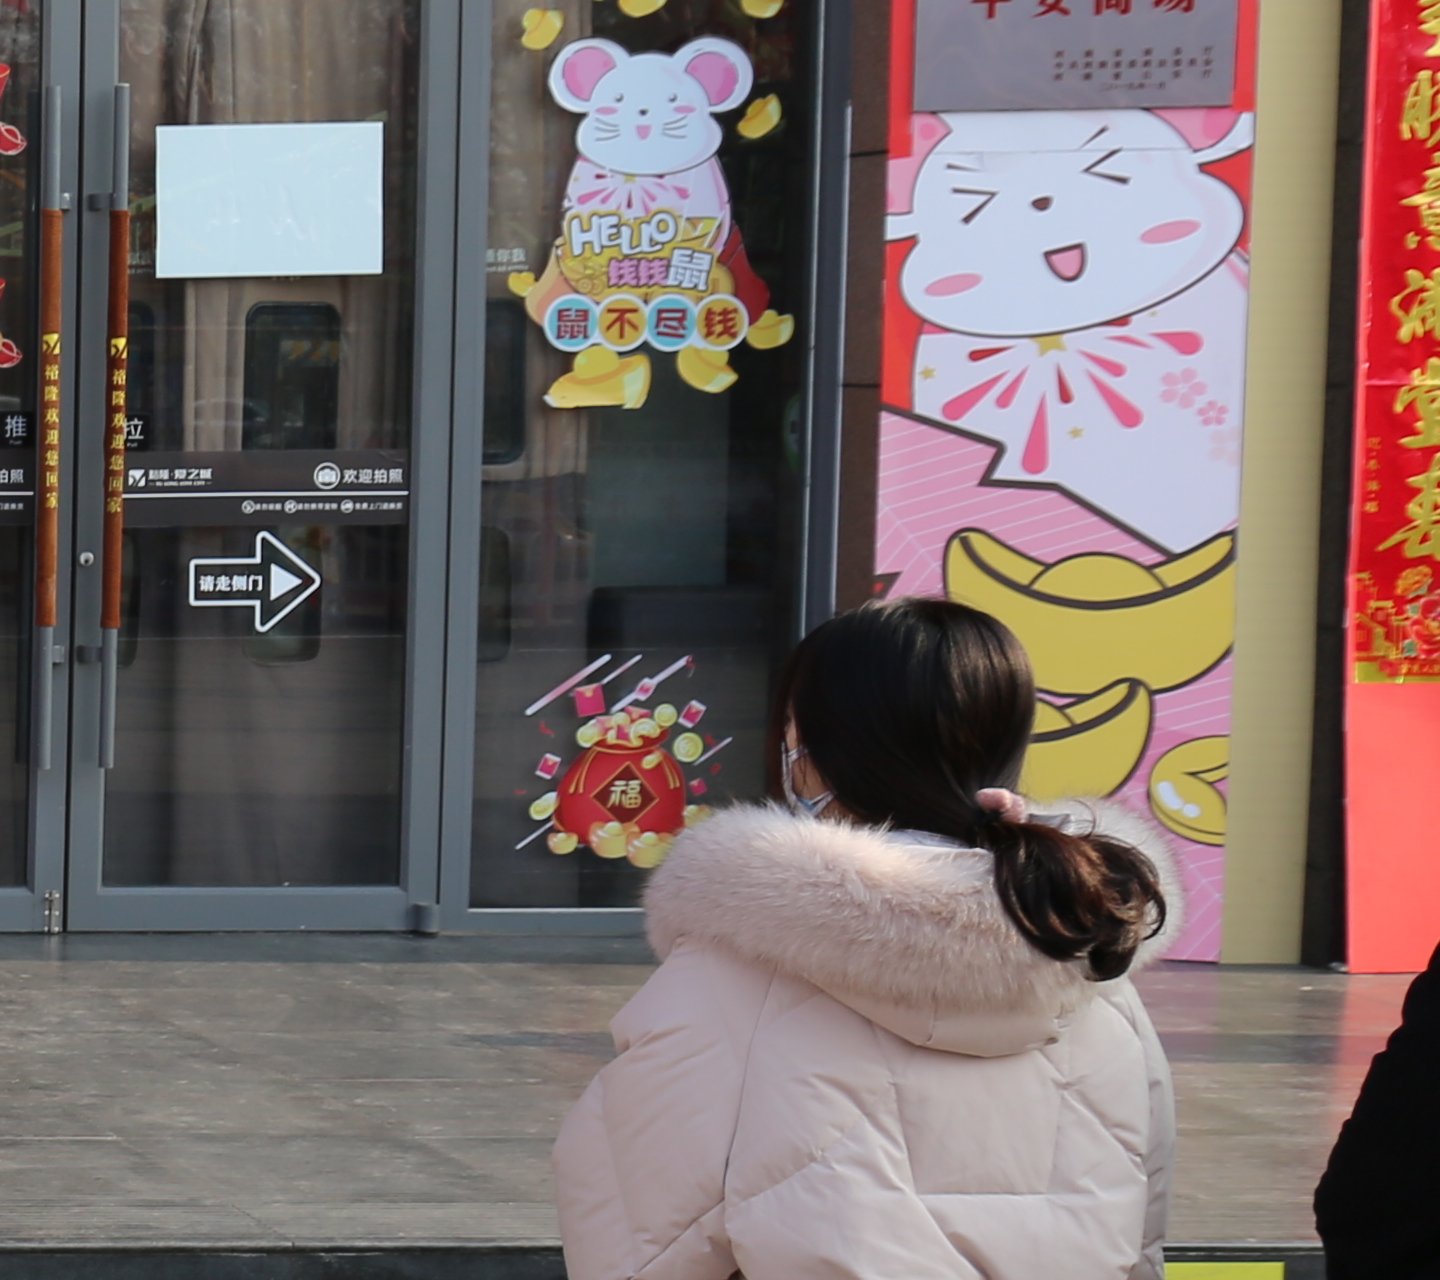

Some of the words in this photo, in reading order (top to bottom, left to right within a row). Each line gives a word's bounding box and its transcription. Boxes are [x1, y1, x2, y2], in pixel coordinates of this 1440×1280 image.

[569, 213, 678, 258] HELLO
[555, 306, 739, 341] 鼠不尽钱
[3, 414, 27, 439] 推
[342, 468, 404, 484] 欢迎拍照
[198, 573, 264, 593] 请走侧门
[607, 779, 643, 809] 福
